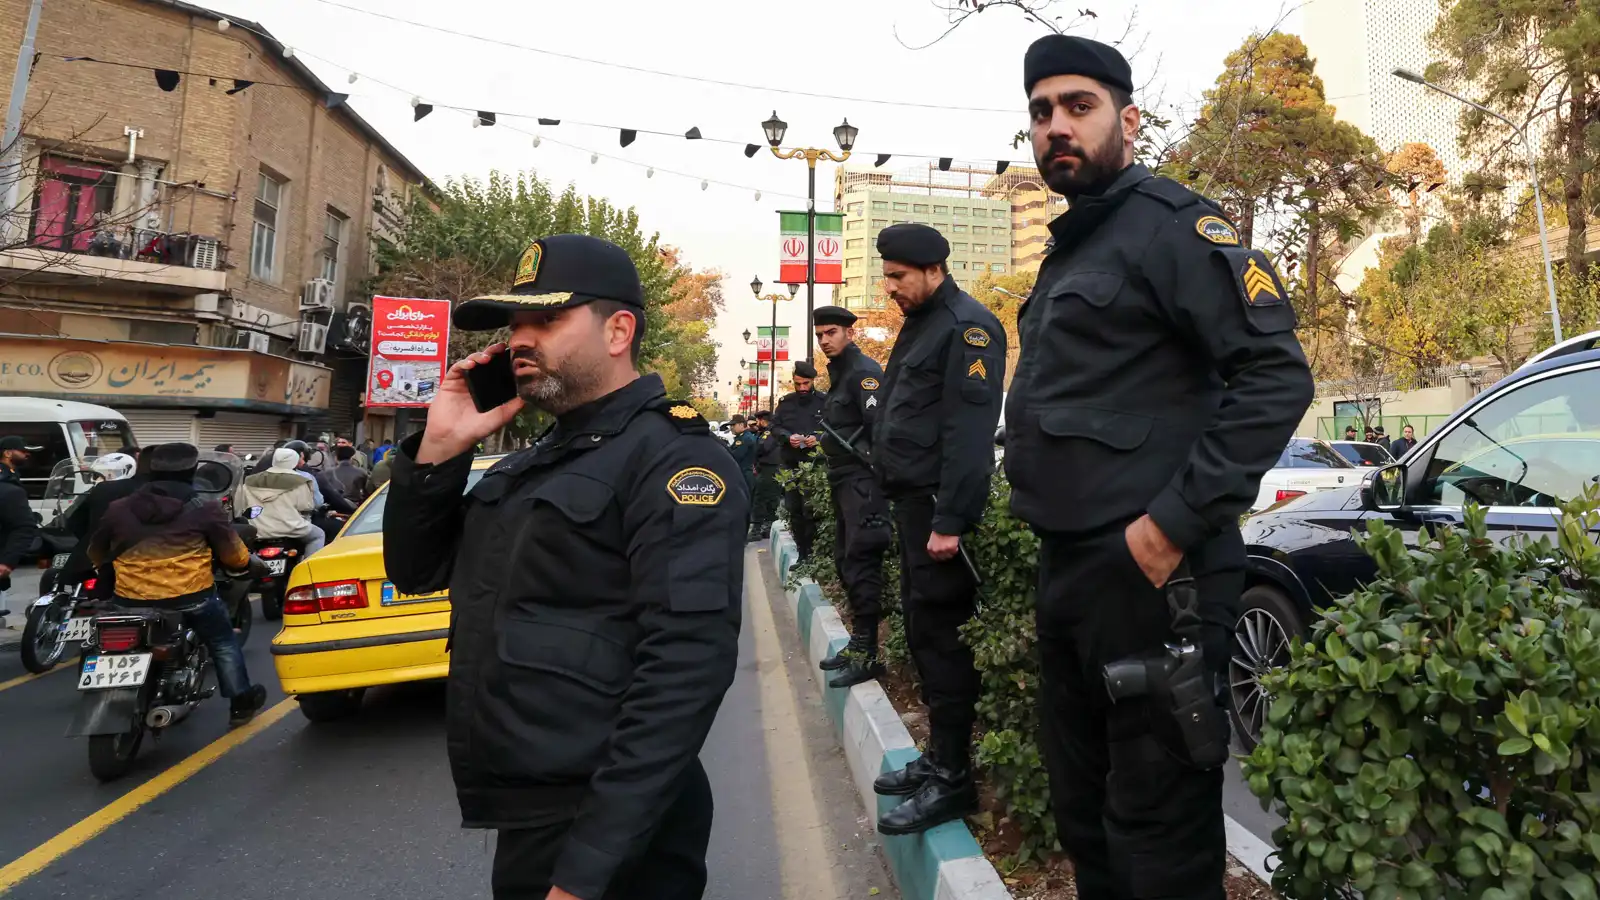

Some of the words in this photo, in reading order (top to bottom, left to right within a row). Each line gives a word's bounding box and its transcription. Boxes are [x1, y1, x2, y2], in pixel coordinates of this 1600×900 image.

[16, 363, 44, 376] CO.
[108, 357, 175, 388] ایران
[178, 363, 216, 389] بیمه
[700, 484, 716, 494] یگان
[681, 494, 714, 502] POLICE
[108, 656, 141, 669] ۱۵۶
